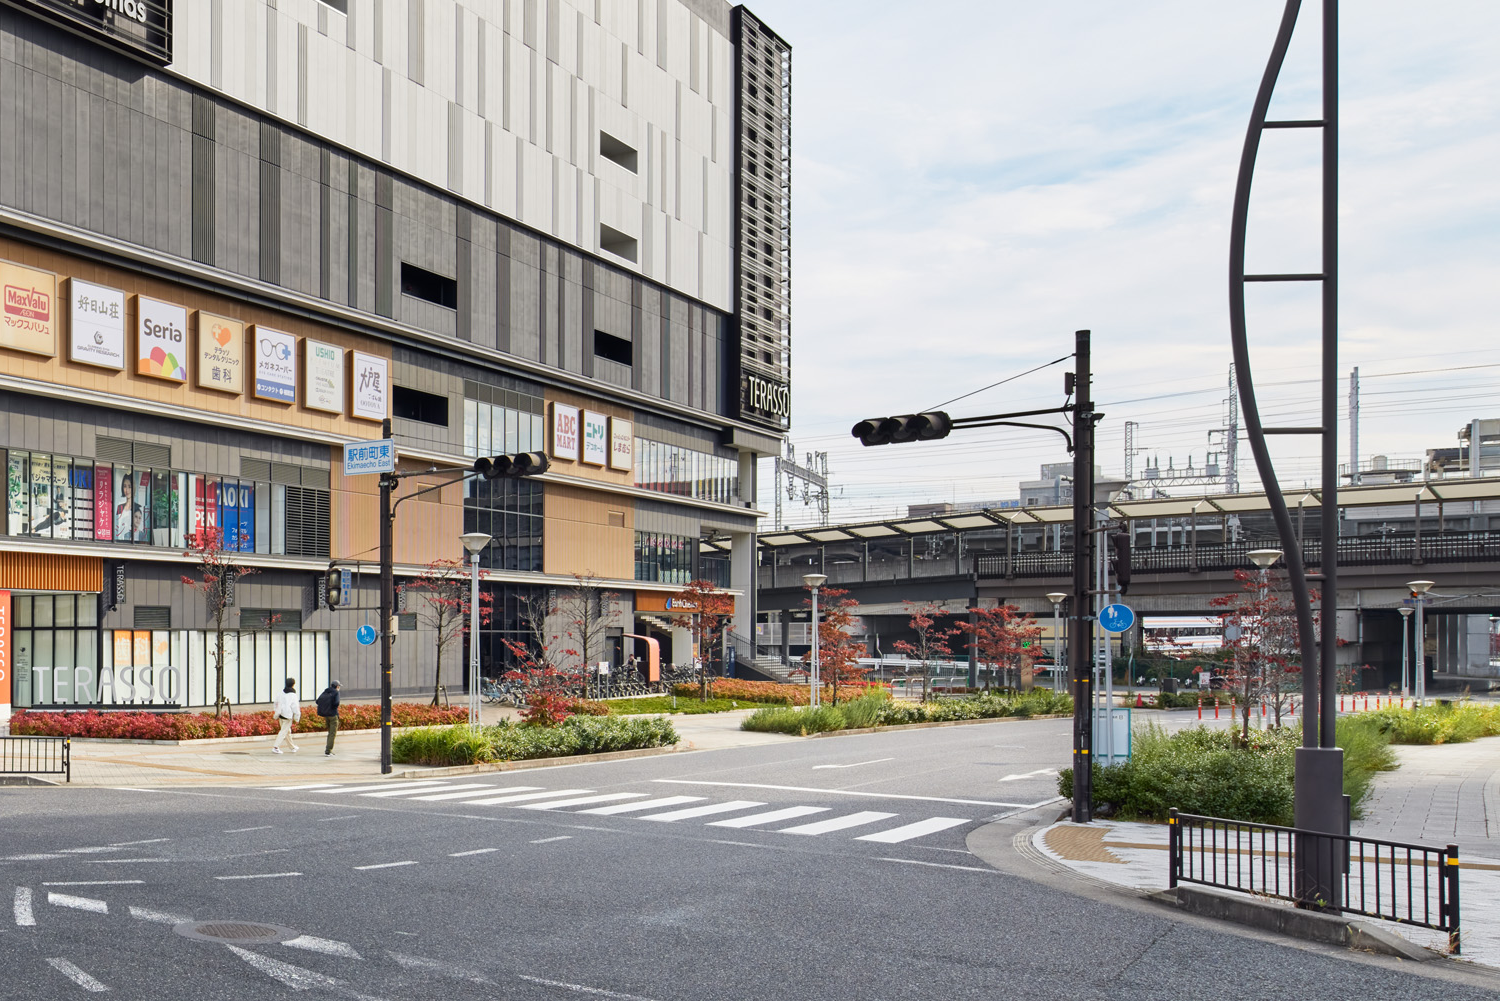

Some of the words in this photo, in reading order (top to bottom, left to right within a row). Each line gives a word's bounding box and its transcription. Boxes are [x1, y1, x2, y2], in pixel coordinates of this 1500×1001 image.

[8, 287, 46, 311] MaxValu
[77, 295, 119, 320] 好日山荘
[4, 316, 50, 335] マックスバリュ
[143, 318, 182, 343] Seria
[316, 346, 335, 360] USHIO
[212, 366, 232, 383] 歯科
[259, 360, 292, 374] メガネスーパー
[359, 366, 382, 393] 大戸屋
[749, 376, 790, 417] TERASSO
[556, 413, 576, 436] ABC
[586, 422, 604, 440] ニトリ
[556, 434, 576, 451] MART
[348, 445, 389, 461] 駅前町東
[347, 461, 376, 470] Ekimaecho
[378, 459, 390, 467] East
[68, 469, 92, 488] OKI
[218, 486, 248, 508] AOKI
[194, 510, 215, 527] PEN
[116, 565, 125, 600] TERASSO
[32, 665, 181, 702] TERASSO
